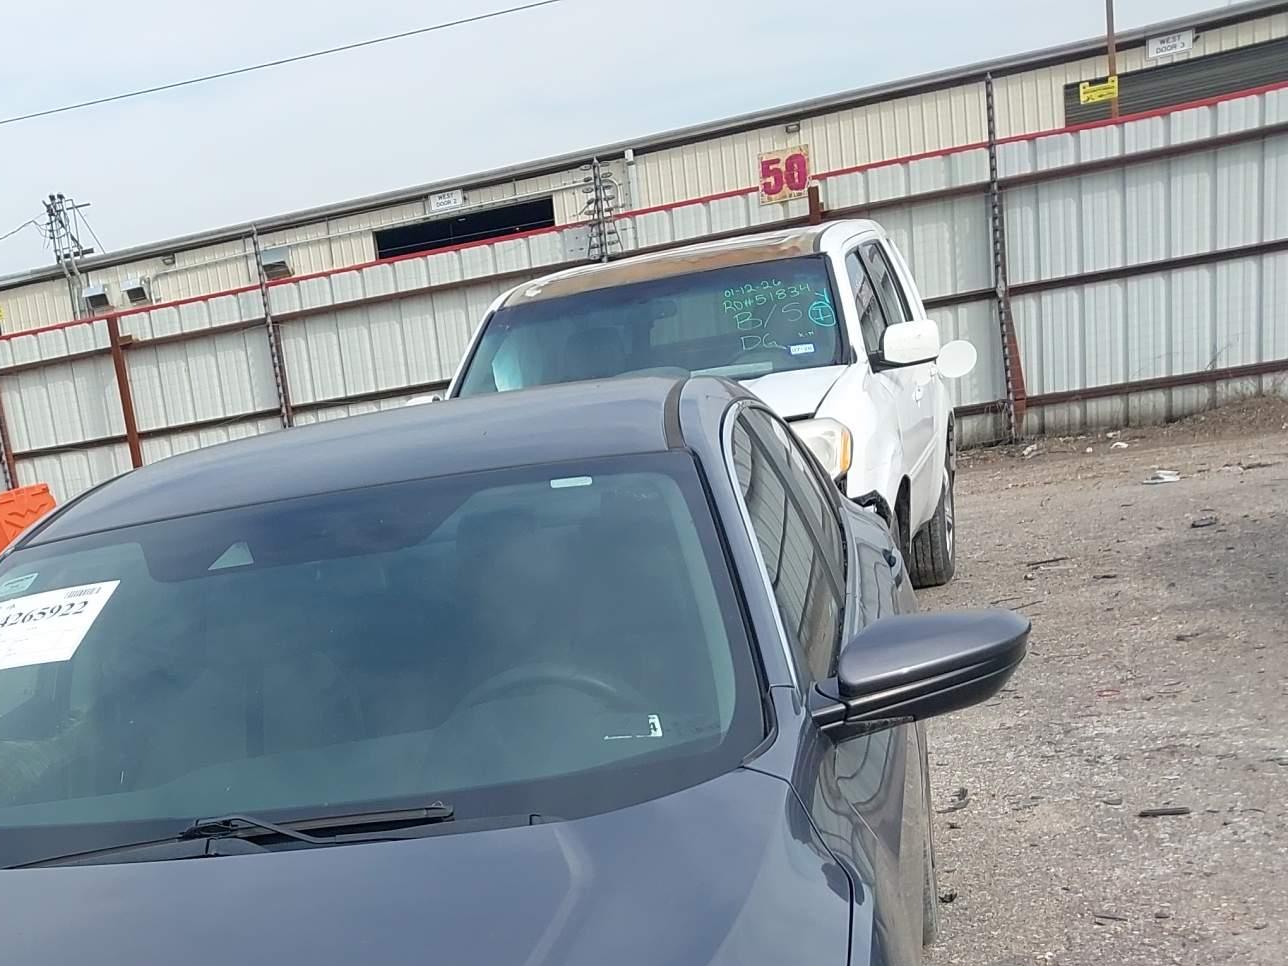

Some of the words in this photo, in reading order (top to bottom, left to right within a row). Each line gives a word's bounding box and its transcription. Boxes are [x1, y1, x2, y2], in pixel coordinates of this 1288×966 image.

[1160, 34, 1182, 44] WEST
[1156, 44, 1177, 53] DOOR
[761, 153, 807, 195] 50
[724, 279, 782, 298] 01-12-26
